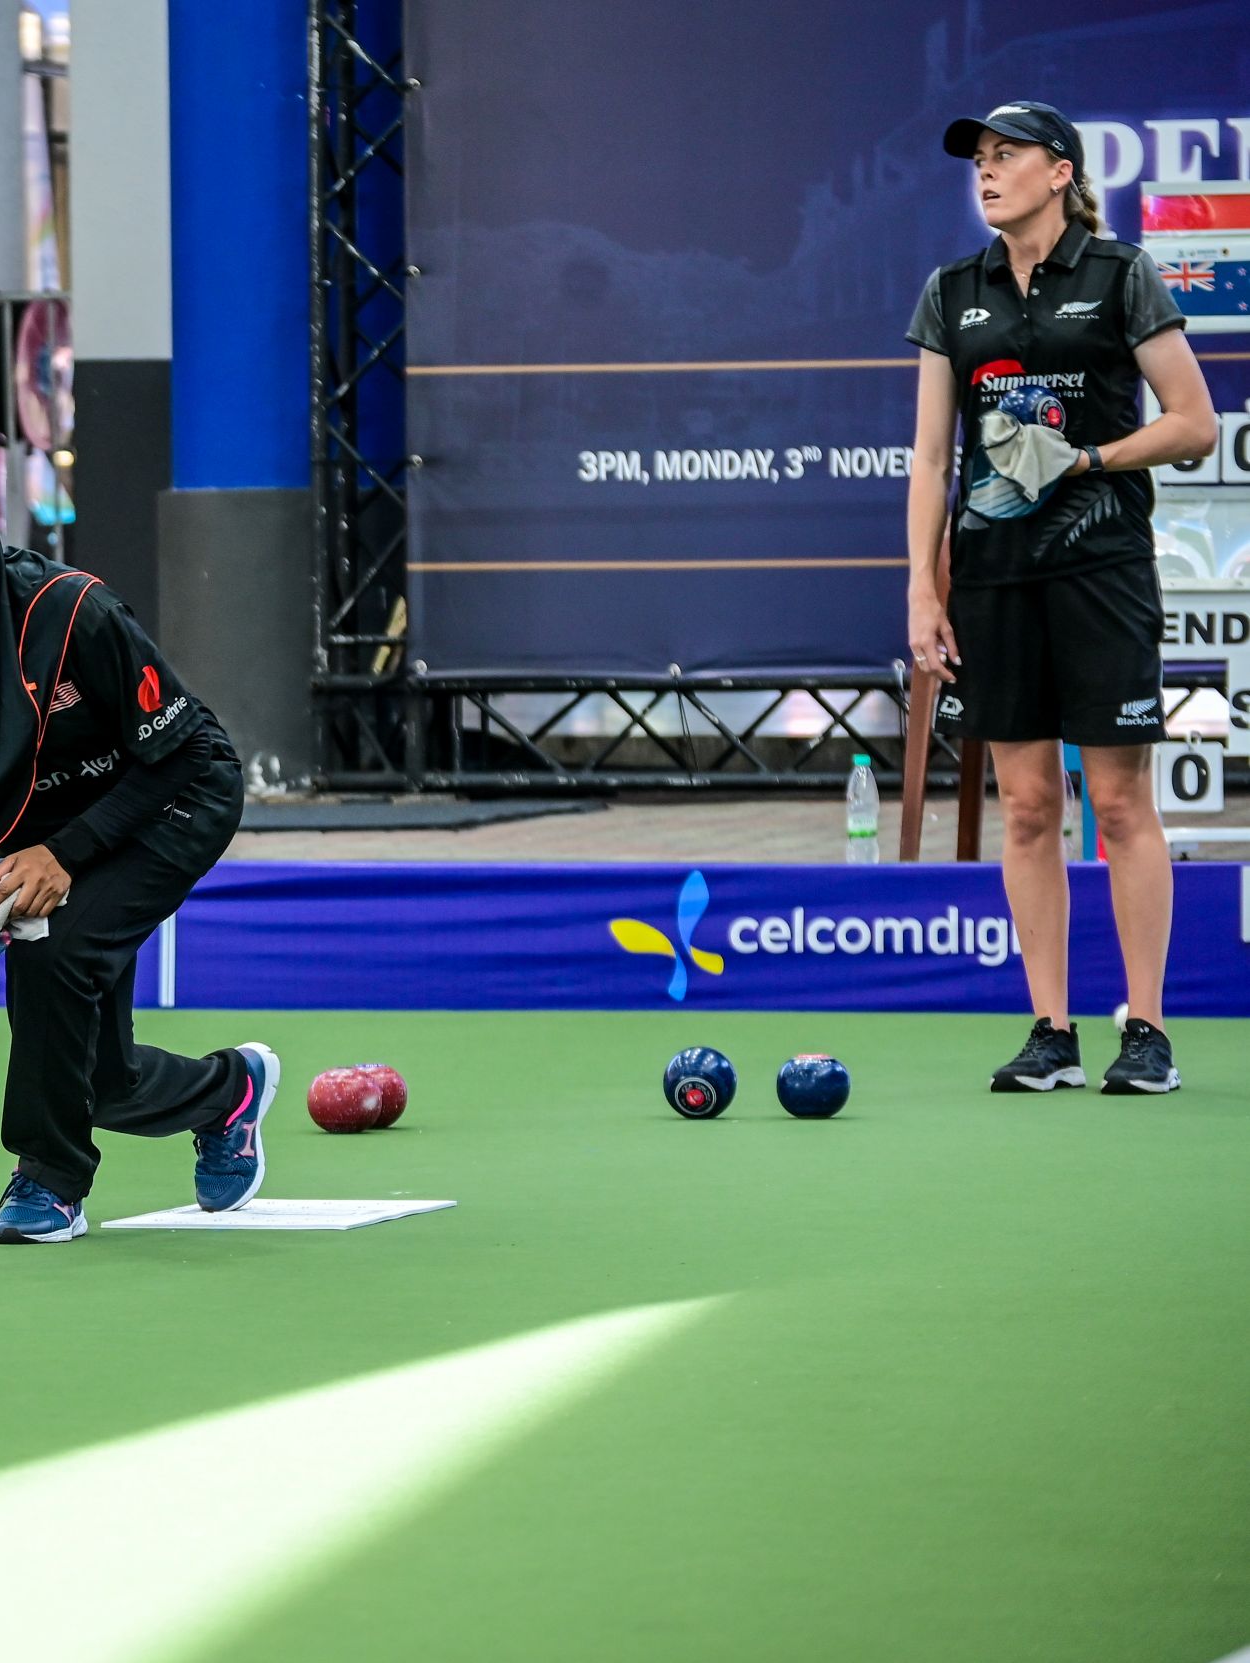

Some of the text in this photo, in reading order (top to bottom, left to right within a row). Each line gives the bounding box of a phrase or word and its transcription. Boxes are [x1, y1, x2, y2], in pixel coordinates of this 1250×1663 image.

[981, 371, 1086, 393] Summerset
[578, 450, 650, 486] 3PM,
[654, 448, 780, 484] MONDAY,
[152, 696, 188, 731] Guthrie
[1171, 754, 1210, 802] 0
